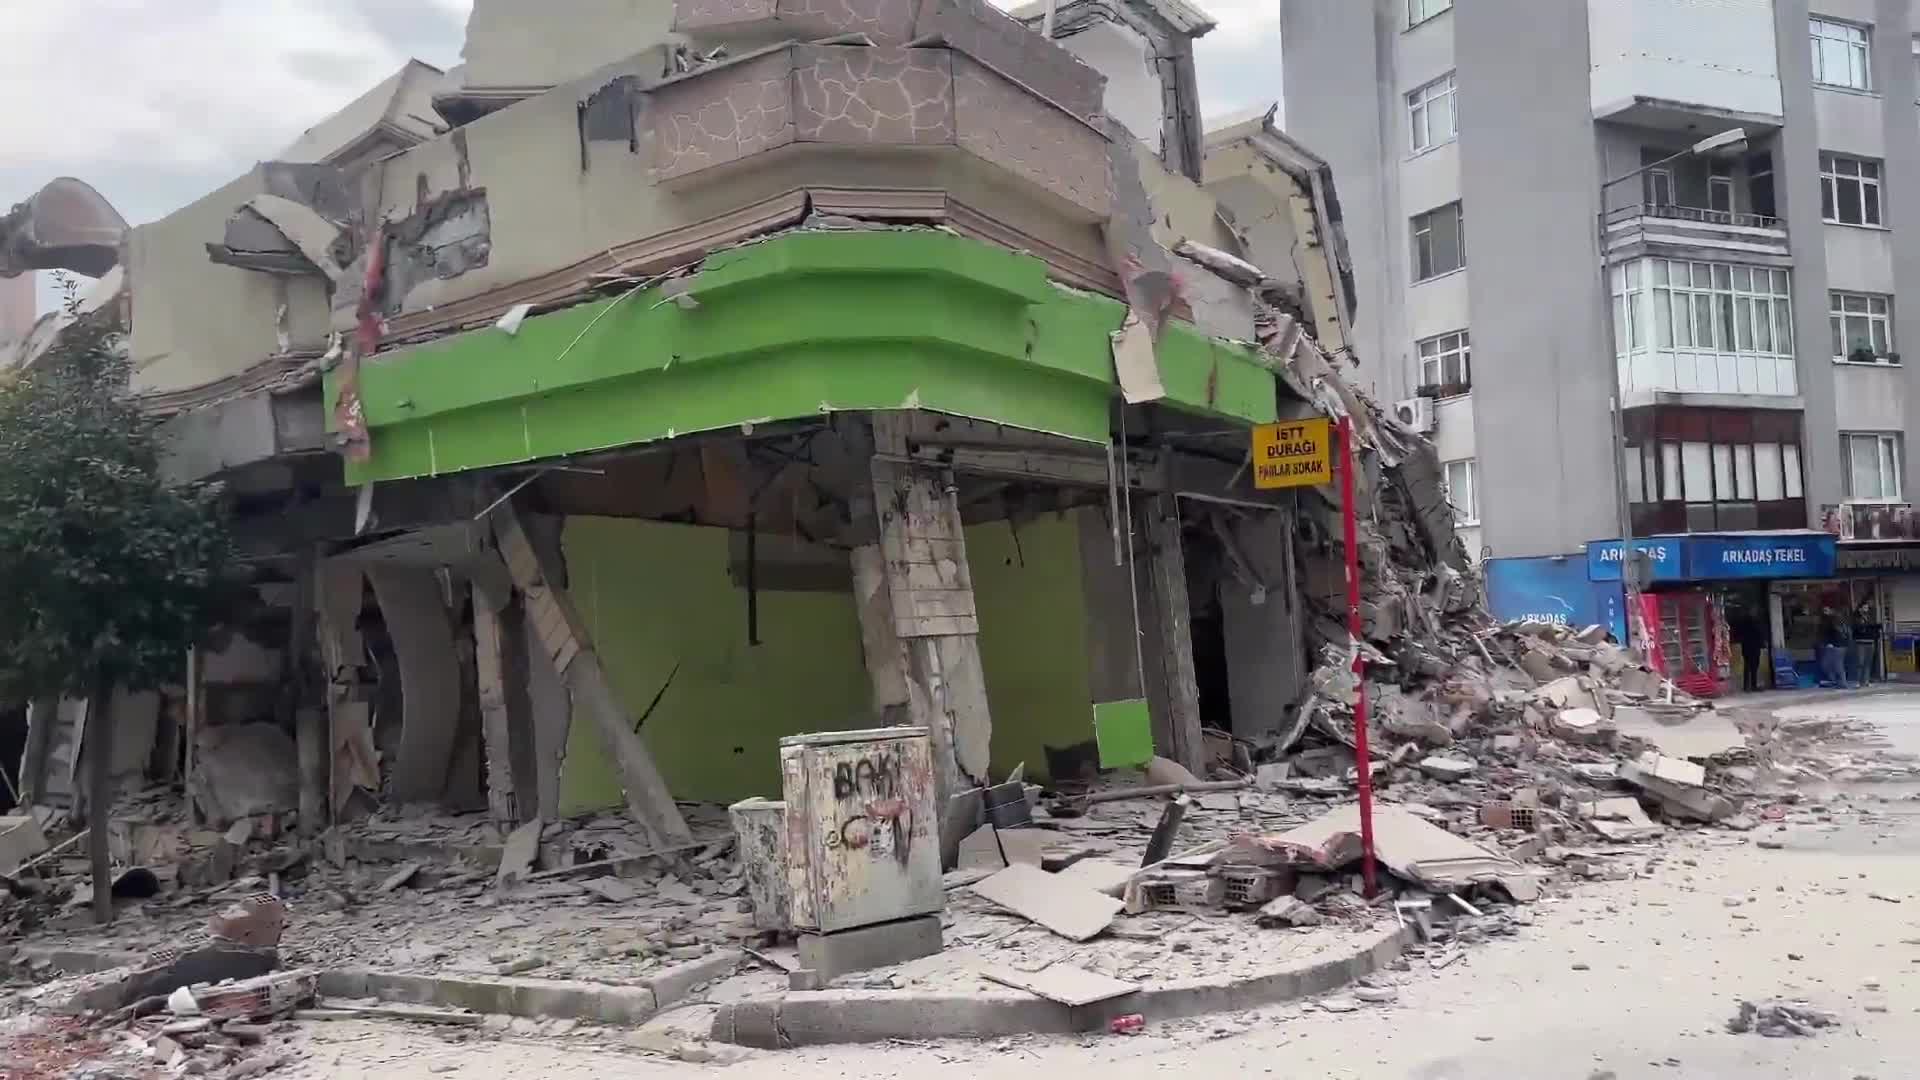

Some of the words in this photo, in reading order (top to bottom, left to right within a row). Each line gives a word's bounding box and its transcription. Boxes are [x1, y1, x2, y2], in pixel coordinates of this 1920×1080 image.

[1267, 440, 1316, 457] DURAĞI
[1293, 459, 1323, 475] SOKAK
[1722, 549, 1772, 566] ARKADAŞ
[1774, 549, 1806, 562] TEKEL
